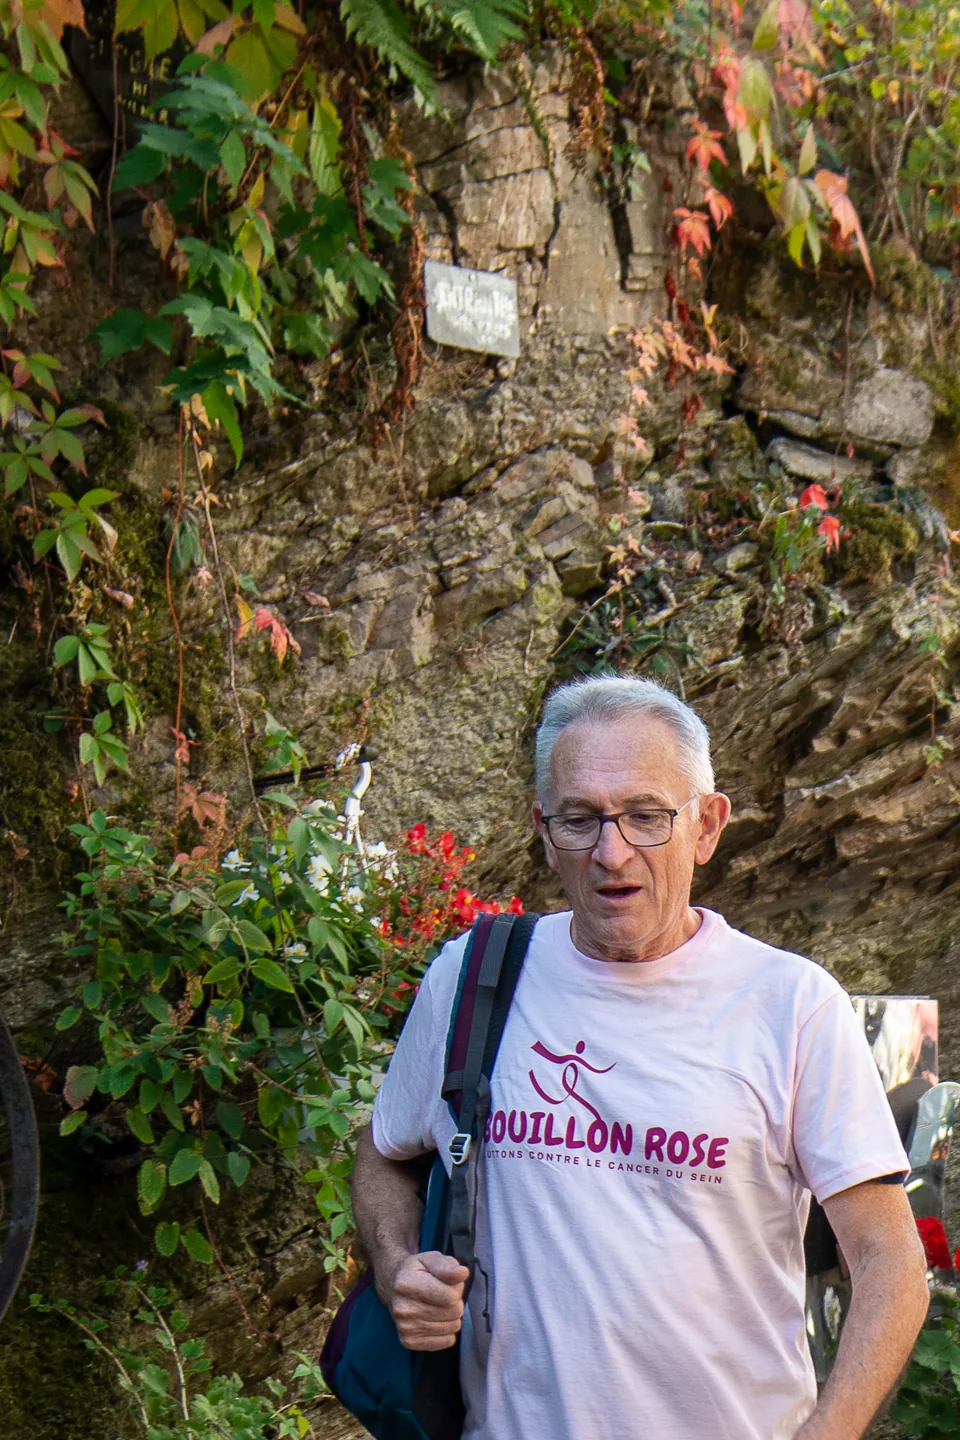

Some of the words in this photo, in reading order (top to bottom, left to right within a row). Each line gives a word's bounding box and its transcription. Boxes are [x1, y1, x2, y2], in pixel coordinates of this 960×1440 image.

[485, 1150, 523, 1159] UTTONS
[528, 1151, 580, 1165] CONTRE
[586, 1158, 601, 1168] LE
[608, 1161, 659, 1175] CANCER
[666, 1169, 683, 1179] DU
[690, 1173, 723, 1184] SEIN
[645, 1127, 729, 1169] ROSE
